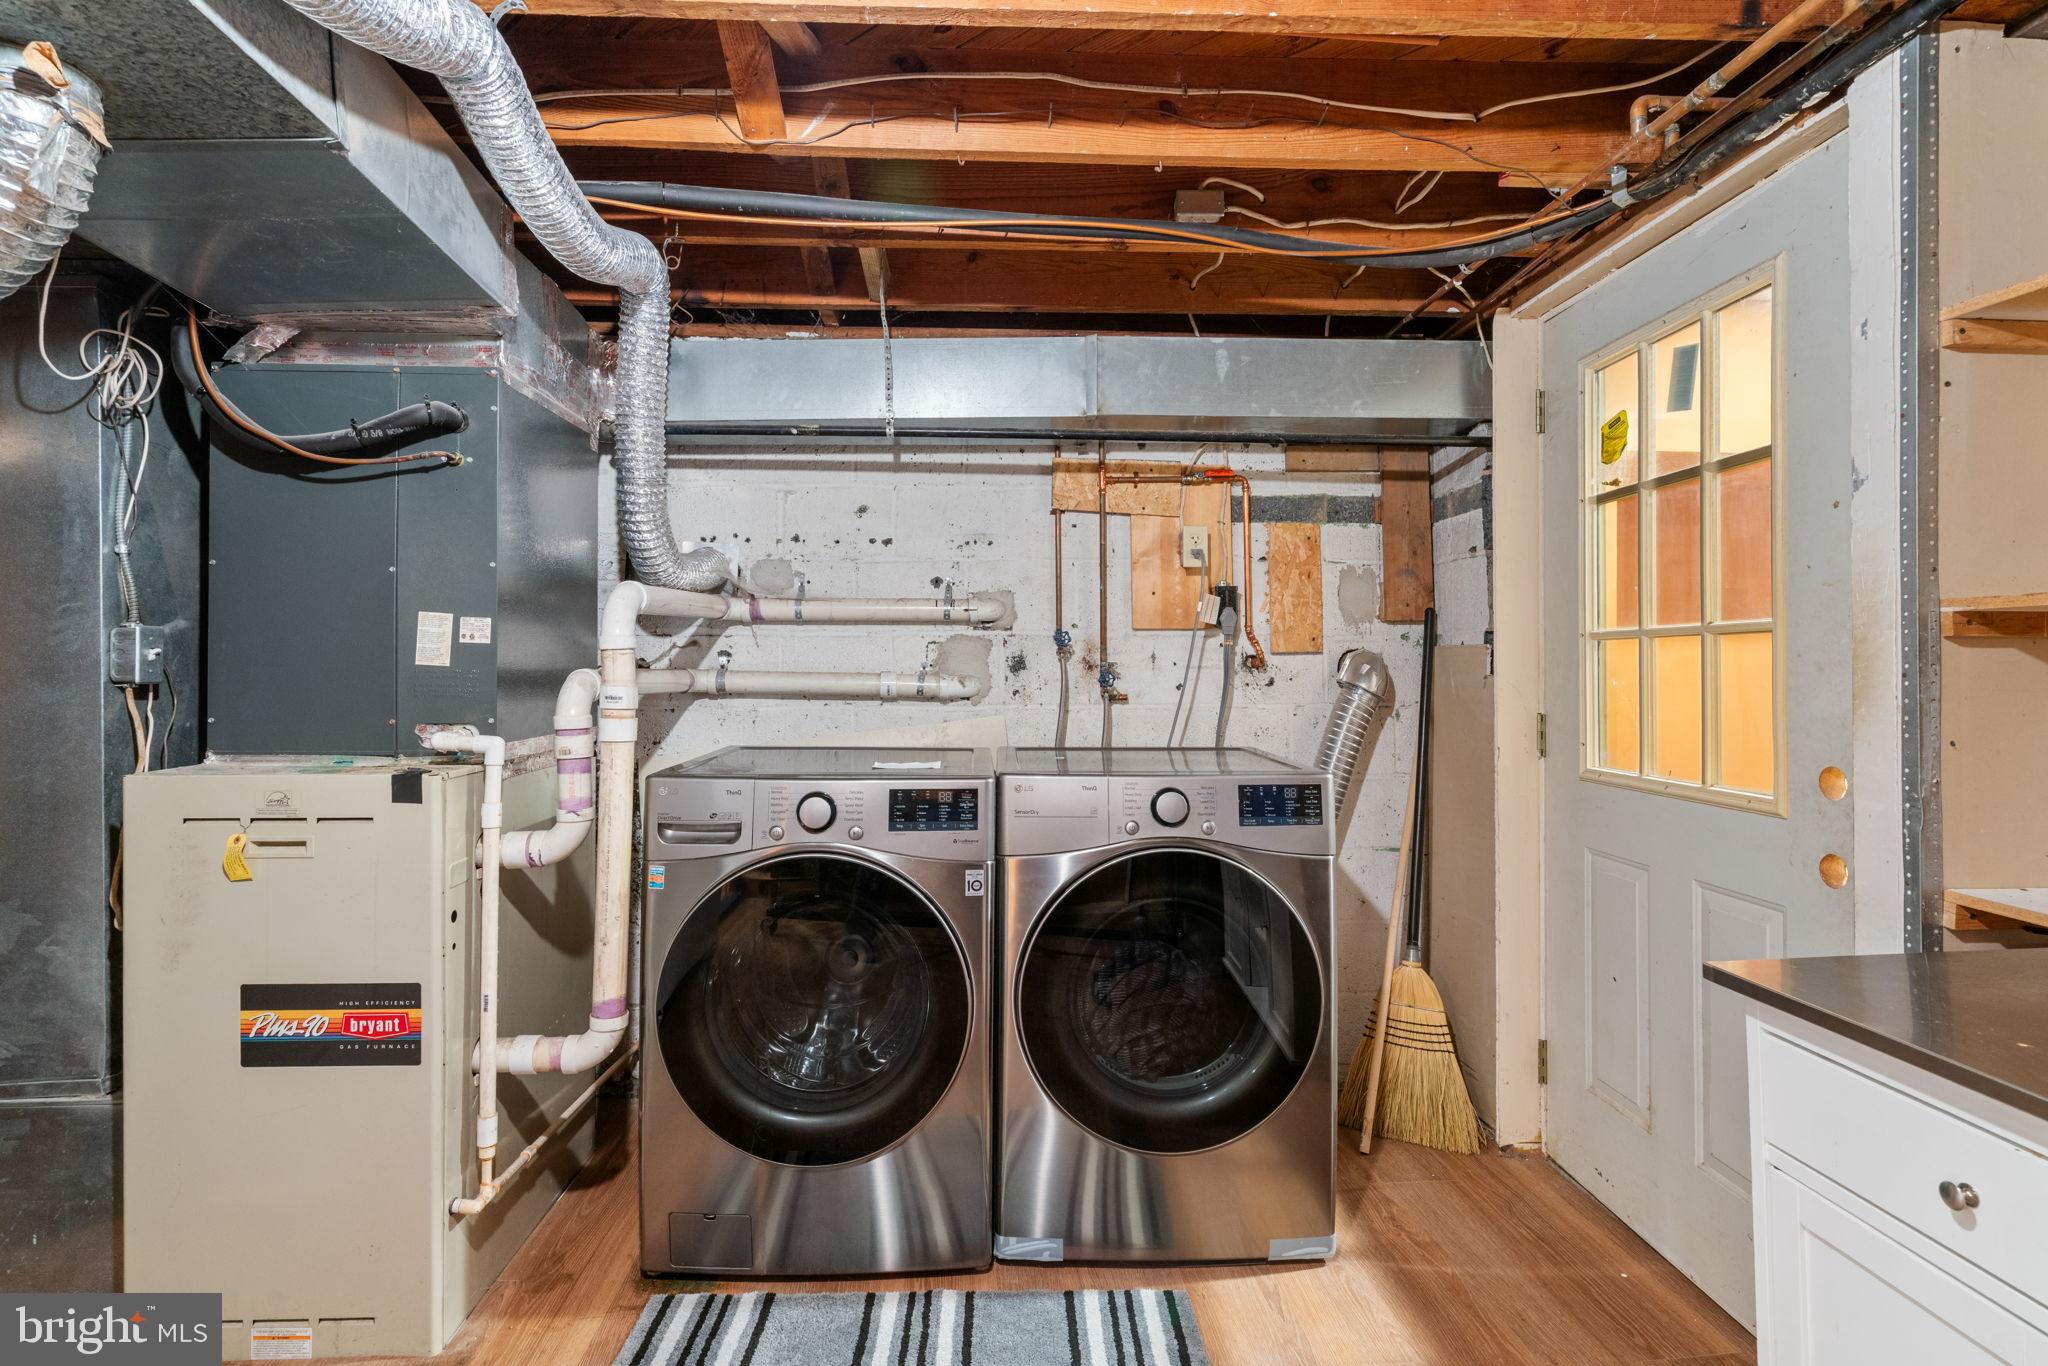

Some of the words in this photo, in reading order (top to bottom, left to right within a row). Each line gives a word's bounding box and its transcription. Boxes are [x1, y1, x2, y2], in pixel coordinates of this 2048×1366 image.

[967, 880, 983, 892] 10
[249, 1012, 304, 1038] Plus
[301, 1014, 330, 1038] 90
[349, 1018, 400, 1035] bryant
